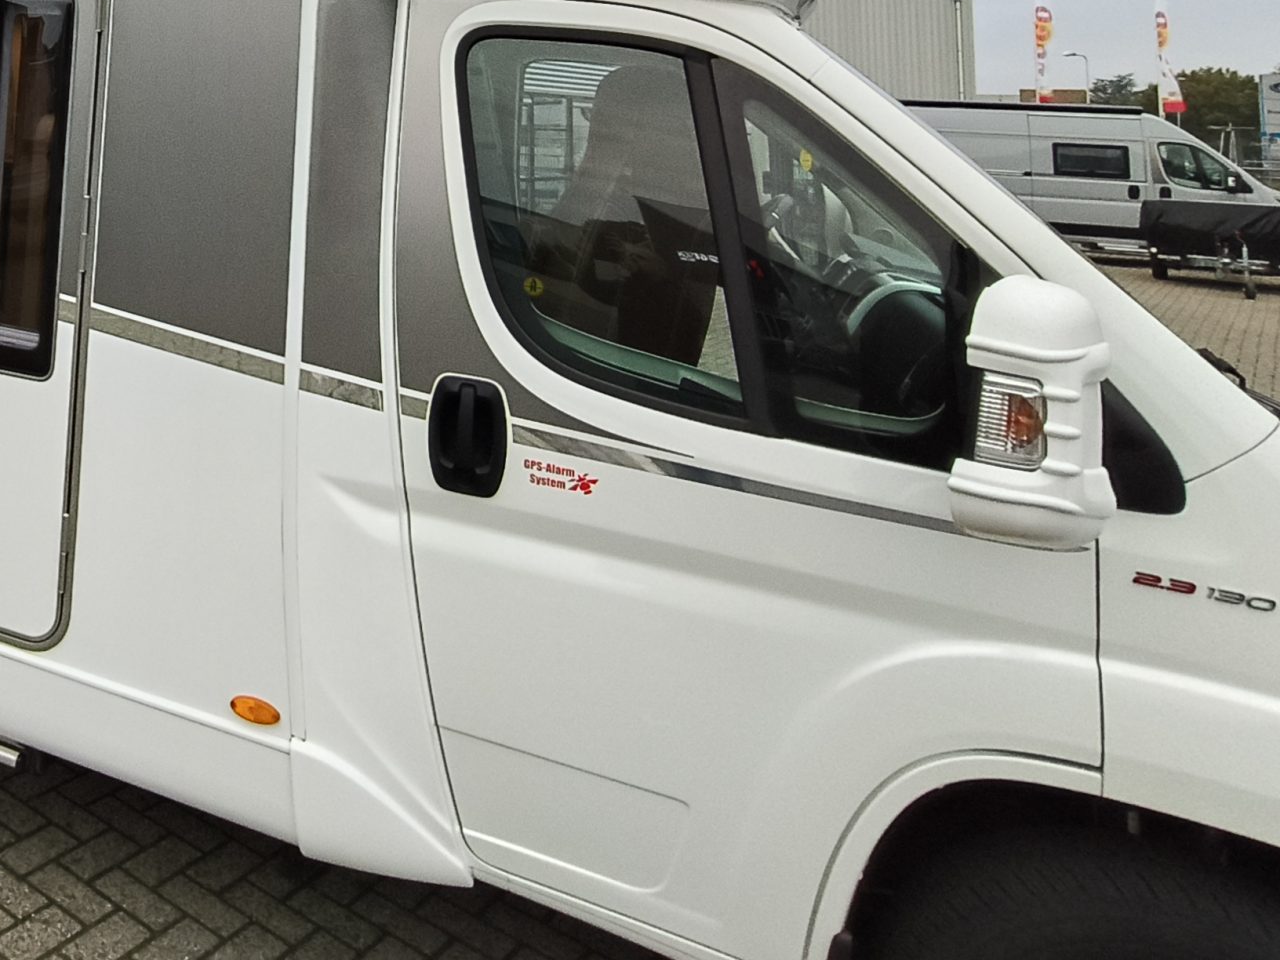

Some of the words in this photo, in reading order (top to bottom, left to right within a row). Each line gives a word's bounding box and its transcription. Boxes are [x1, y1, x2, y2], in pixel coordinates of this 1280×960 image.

[523, 459, 575, 477] GPS-Alarm
[529, 473, 566, 490] System
[1132, 571, 1197, 594] 2.3
[1206, 586, 1277, 612] 130
